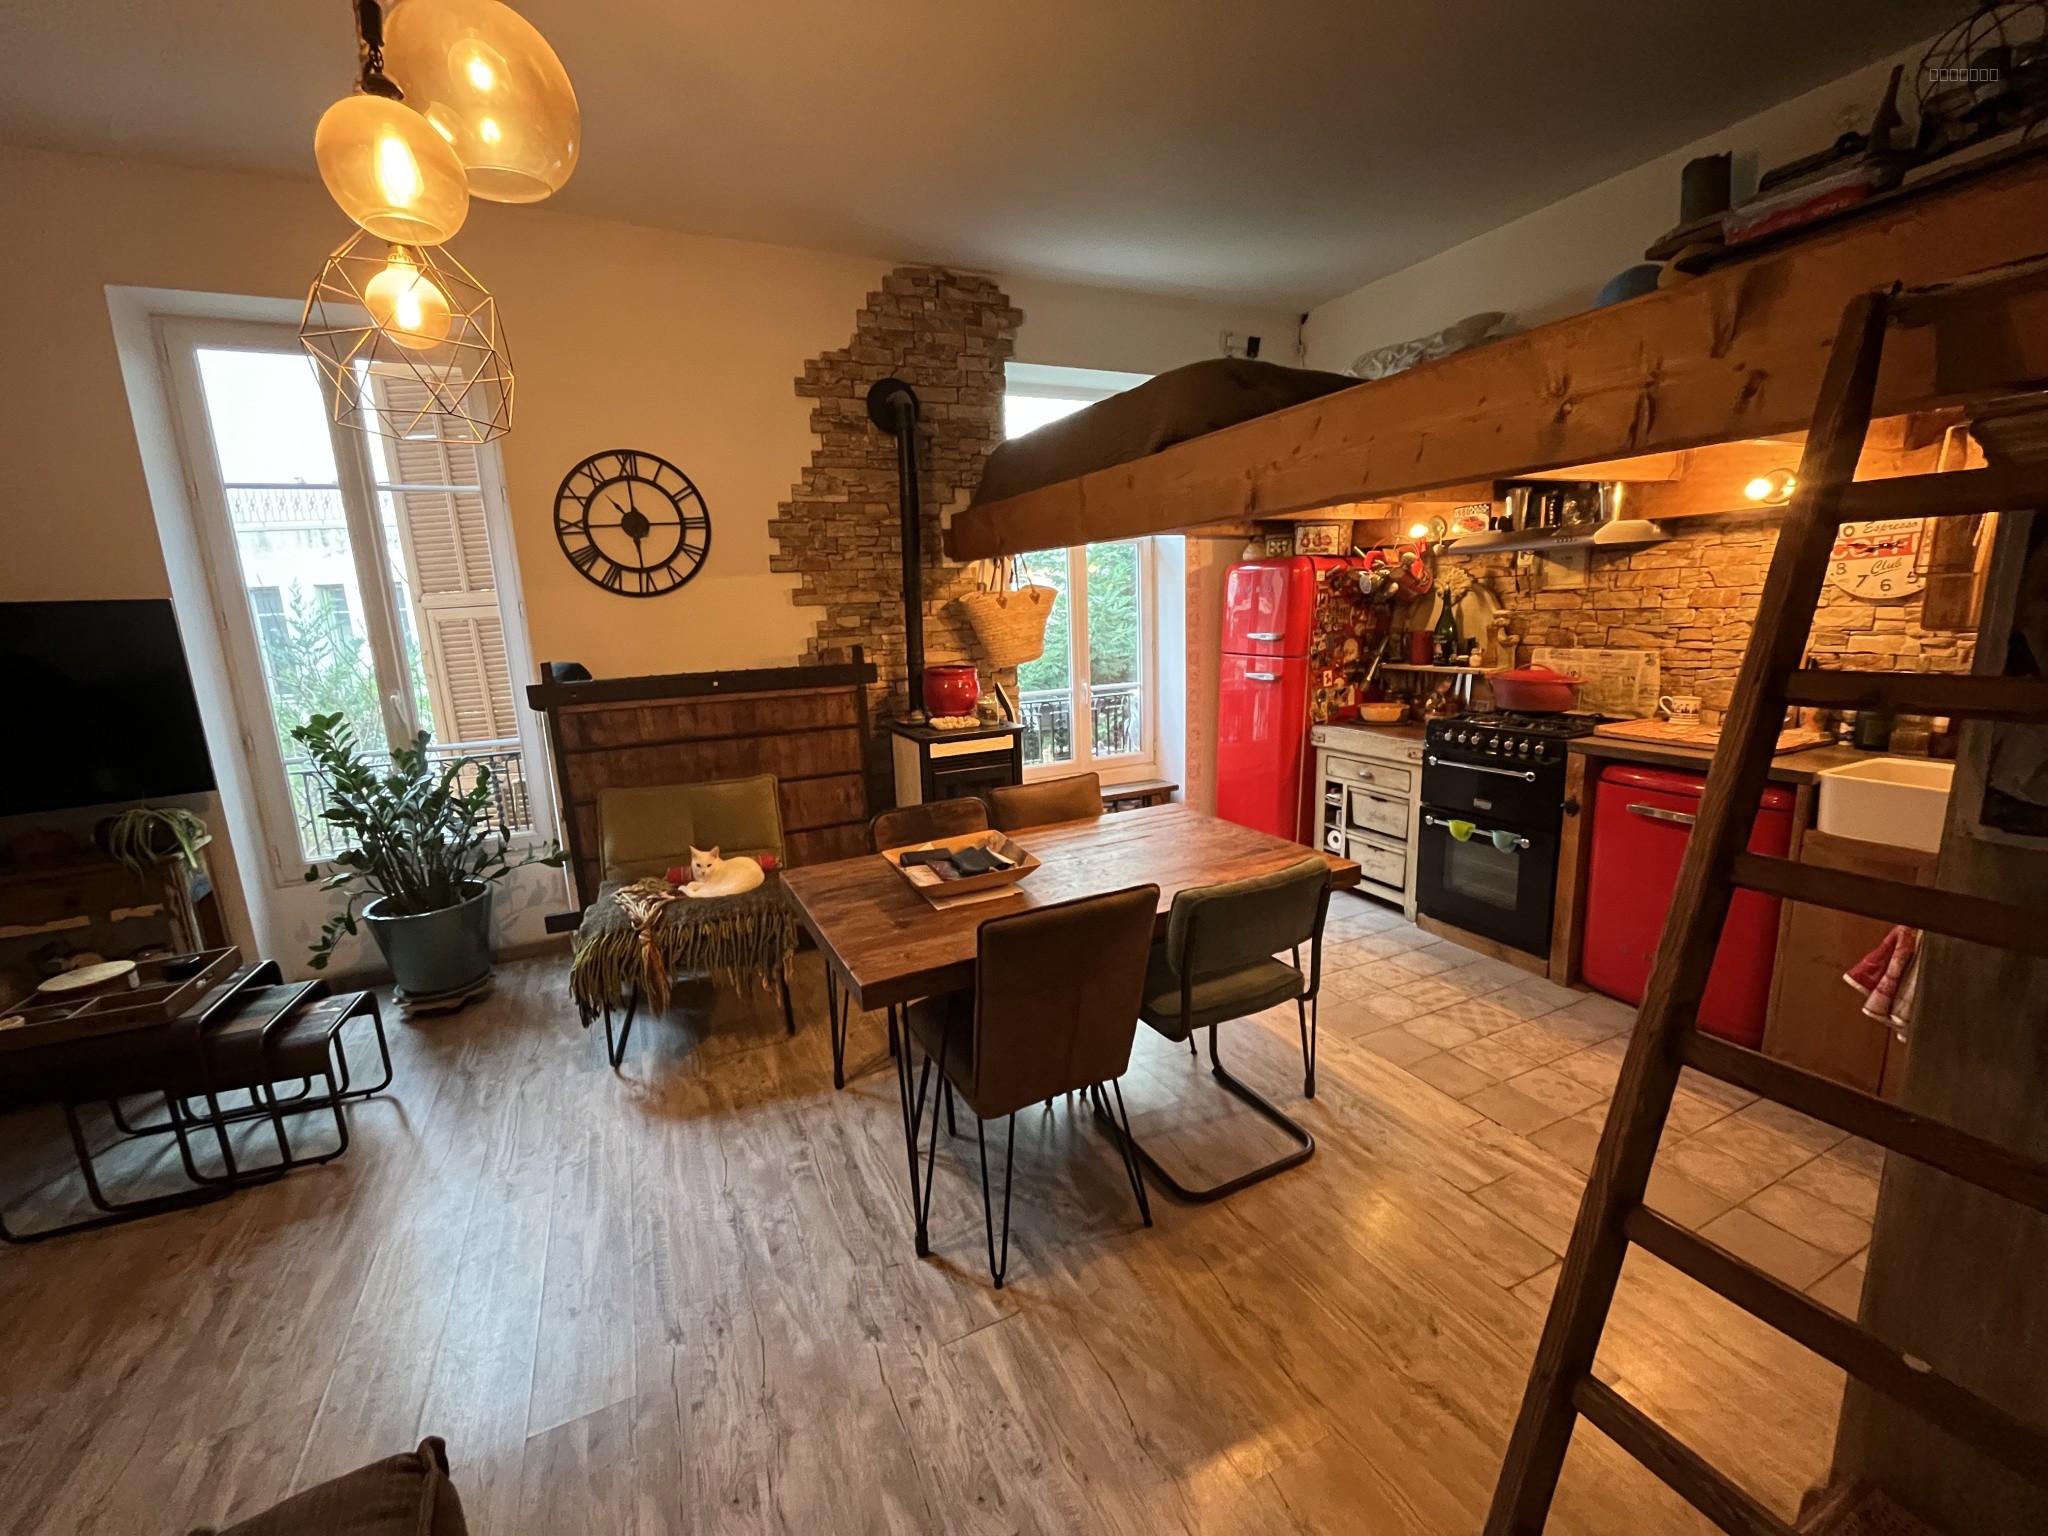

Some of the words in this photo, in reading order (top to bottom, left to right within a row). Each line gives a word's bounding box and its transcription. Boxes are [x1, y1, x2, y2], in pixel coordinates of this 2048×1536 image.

[1863, 521, 1918, 534] Espresso
[1836, 562, 1847, 576] 8
[1870, 557, 1903, 575] Club
[1856, 574, 1870, 588] 7
[1880, 578, 1892, 592] 6
